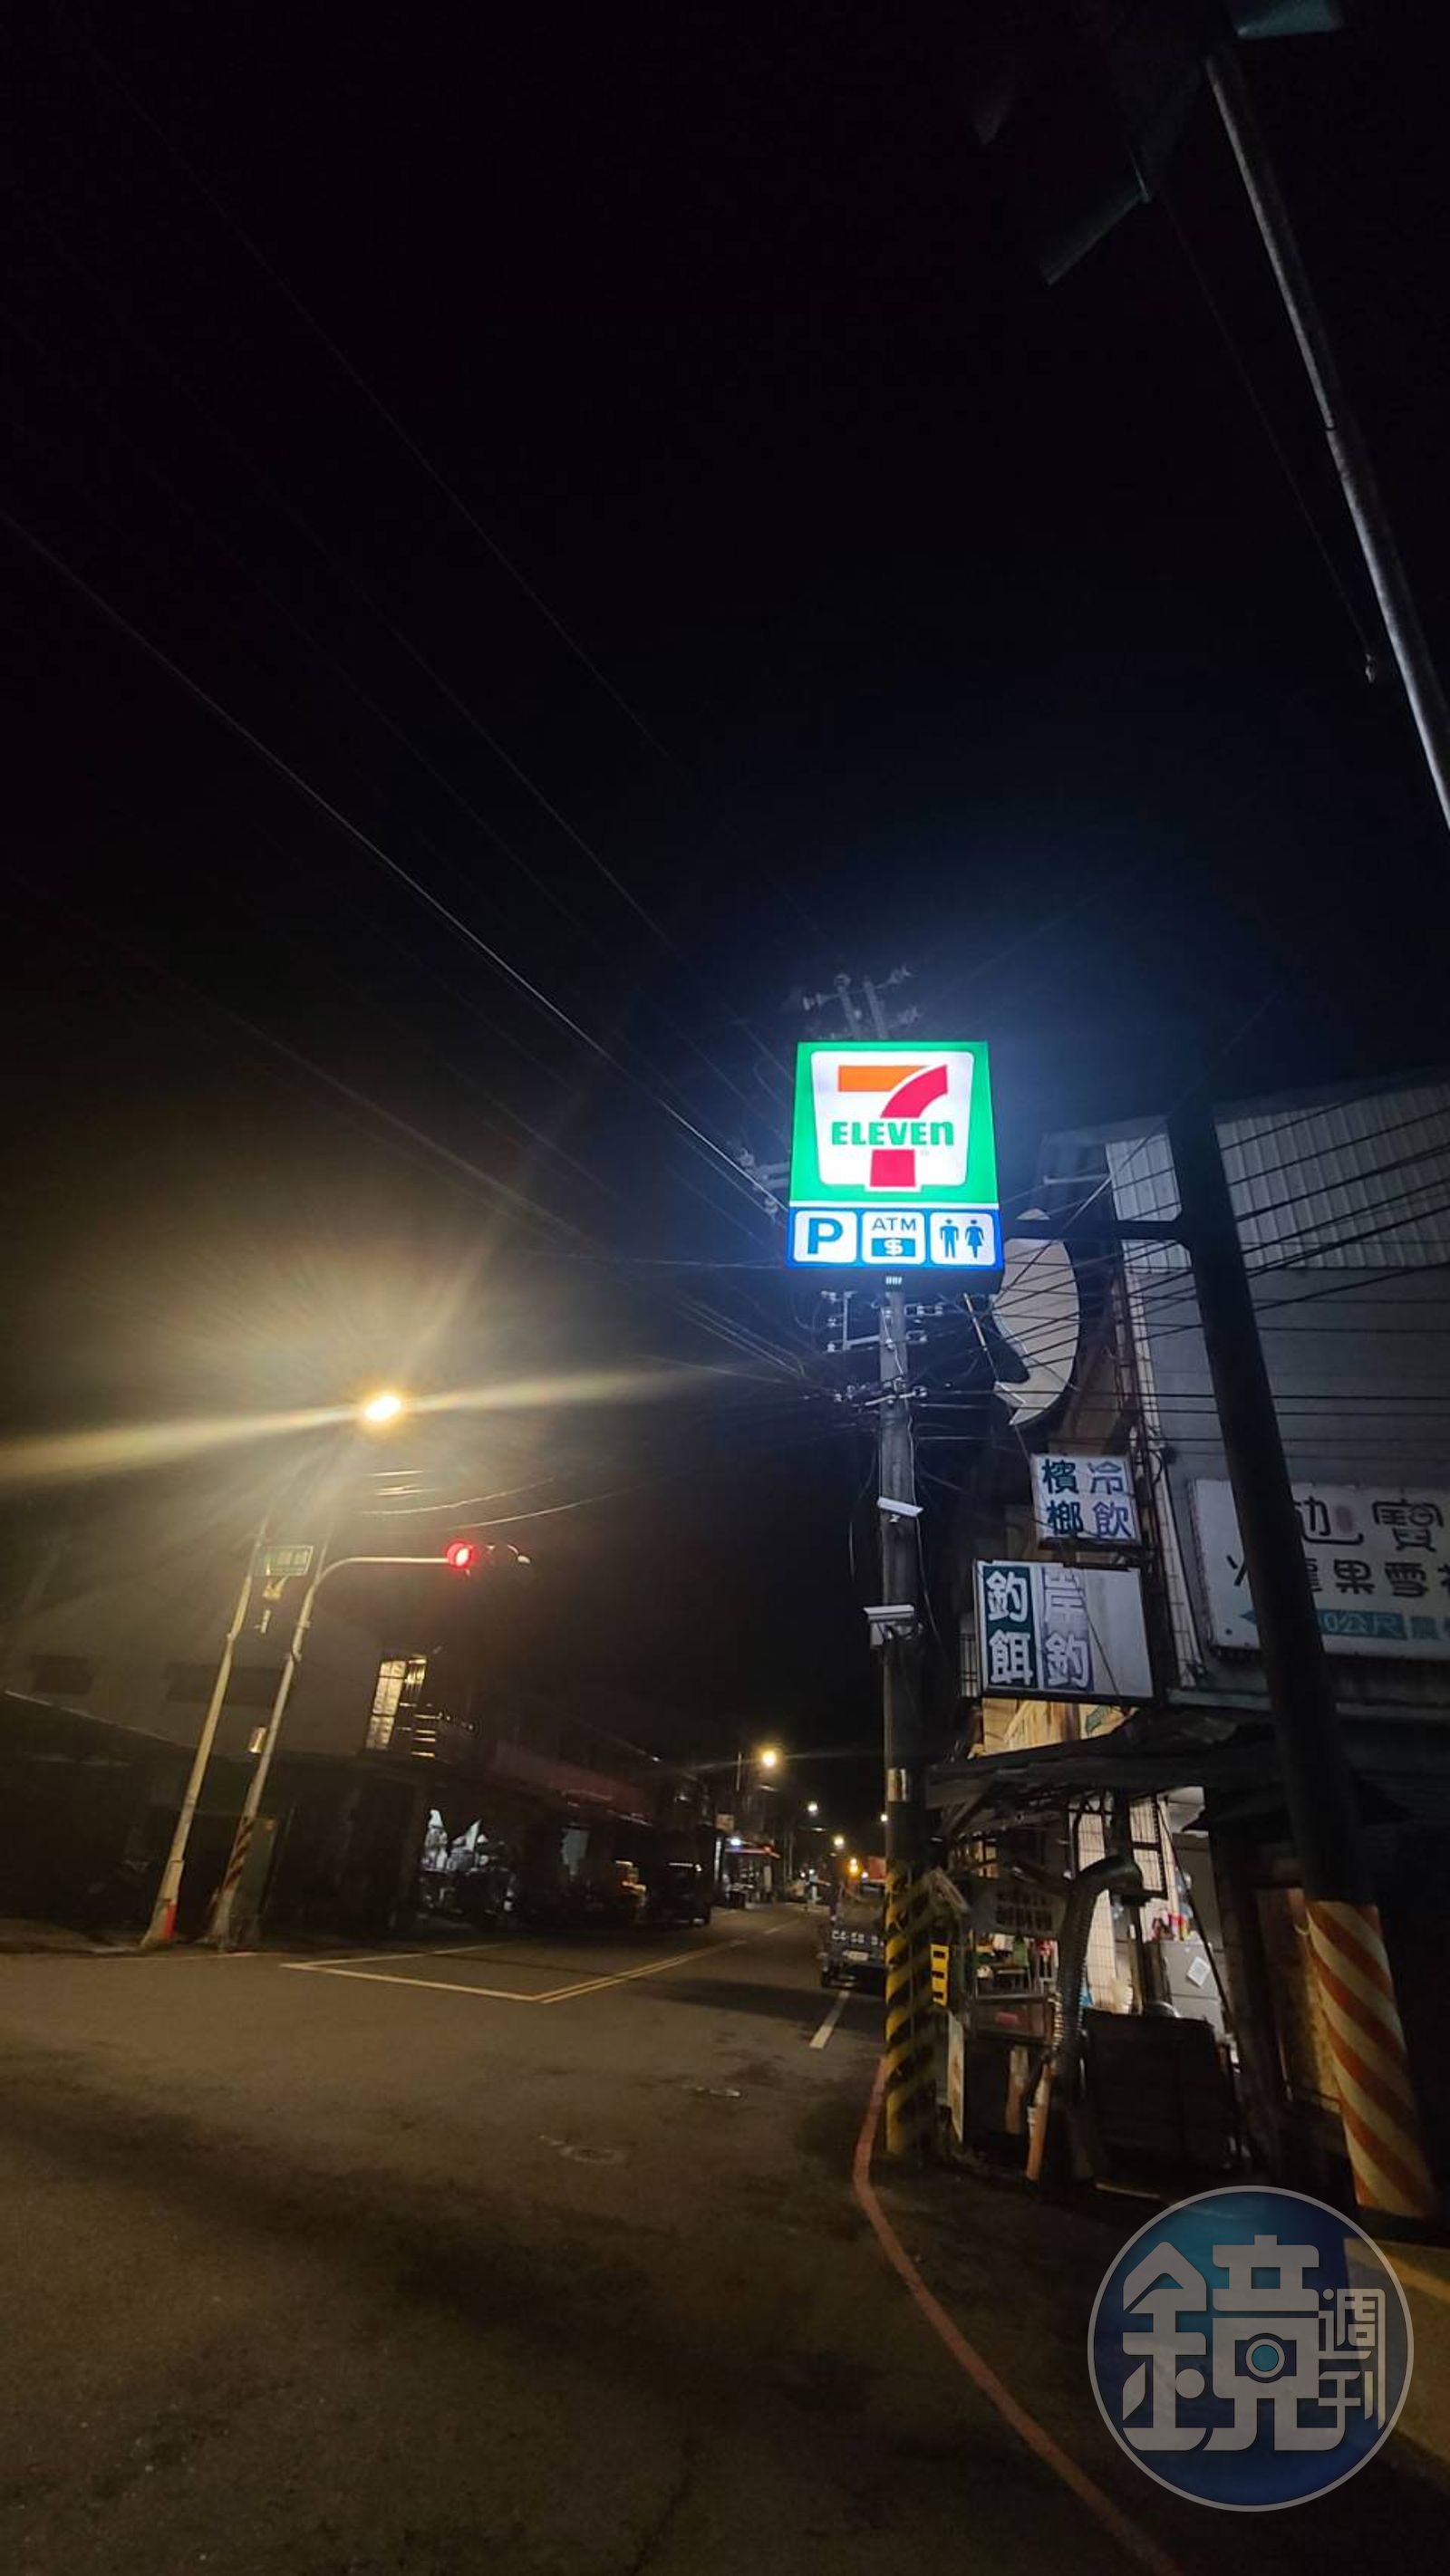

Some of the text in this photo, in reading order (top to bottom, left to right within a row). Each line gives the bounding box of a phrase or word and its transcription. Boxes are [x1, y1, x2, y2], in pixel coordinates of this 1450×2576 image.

[837, 1065, 948, 1188] 7
[807, 1217, 844, 1255] P
[872, 1217, 917, 1231] ATM
[1041, 1460, 1083, 1535] 檳榔
[1088, 1461, 1131, 1538] 冷飲
[986, 1571, 1033, 1686] 釣餌
[1044, 1572, 1088, 1688] 岸釣
